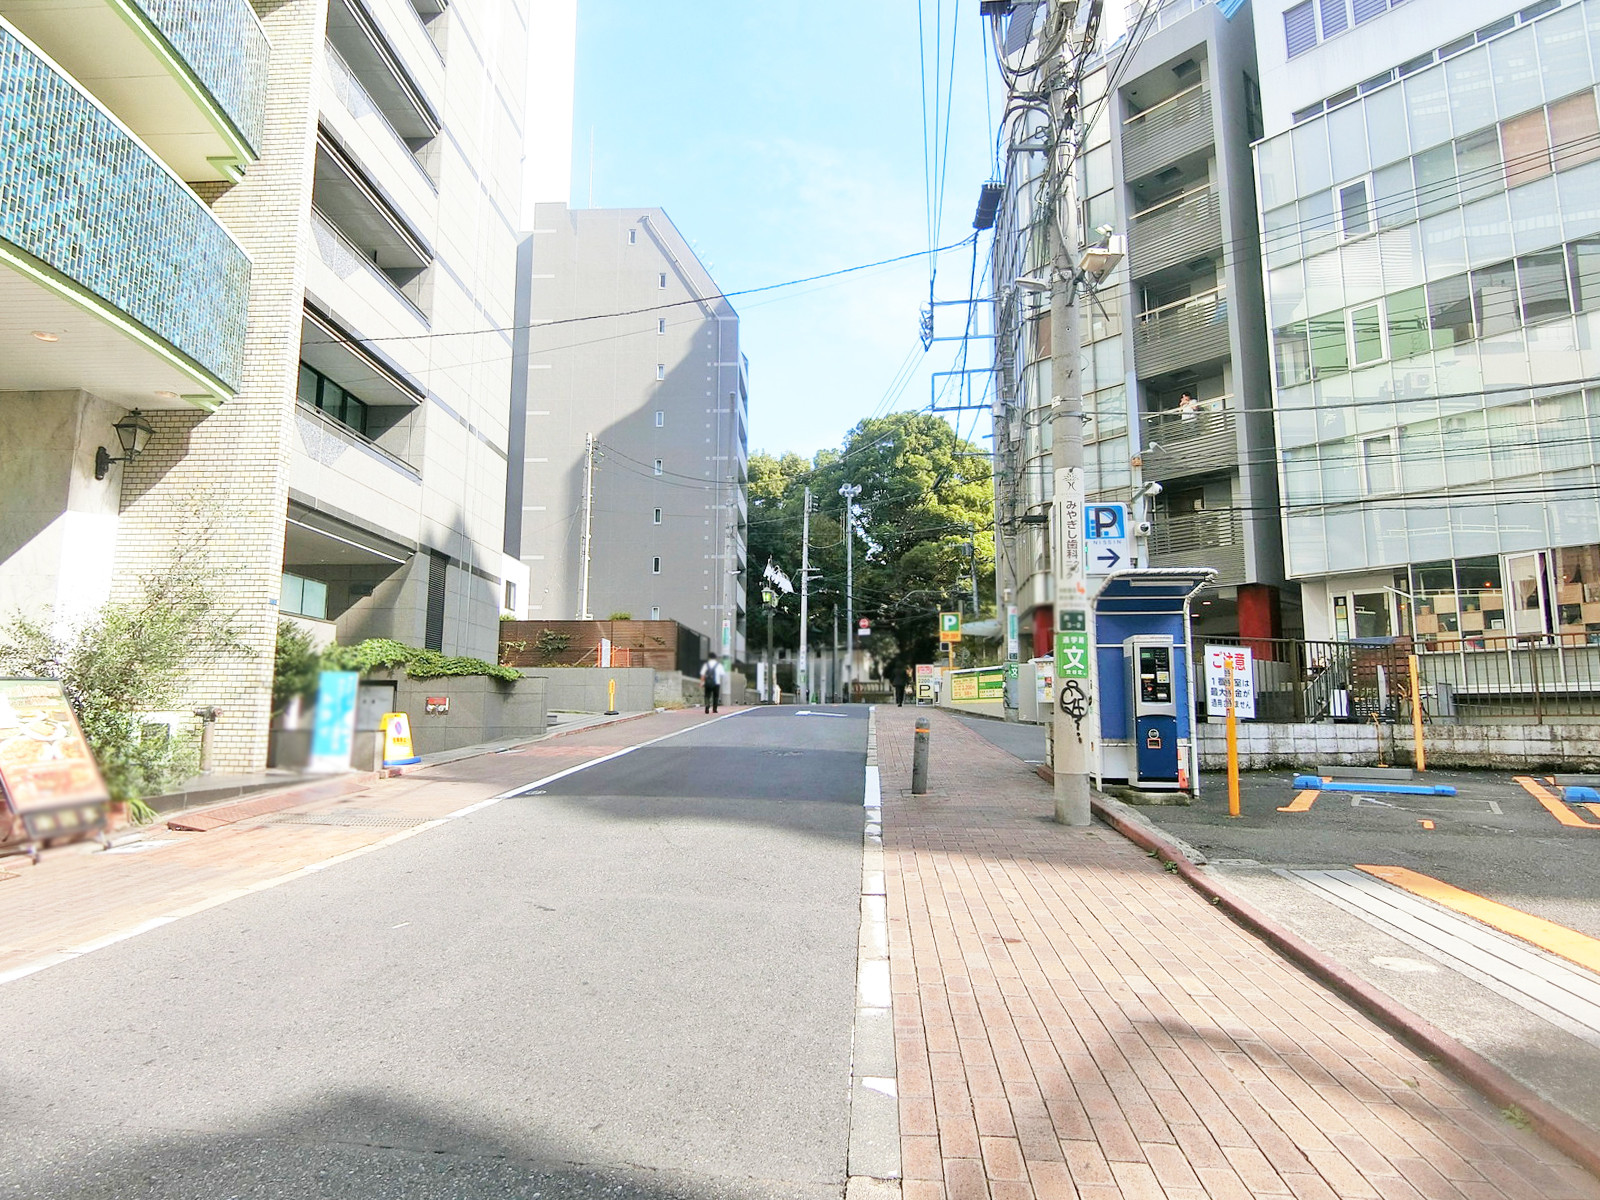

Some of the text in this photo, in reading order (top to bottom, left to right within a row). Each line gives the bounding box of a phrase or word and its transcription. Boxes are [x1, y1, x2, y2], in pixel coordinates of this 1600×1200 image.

[1094, 507, 1117, 538] P
[943, 615, 957, 631] P
[1063, 645, 1085, 669] 文
[919, 684, 931, 696] P
[1210, 687, 1250, 698] 最大金が
